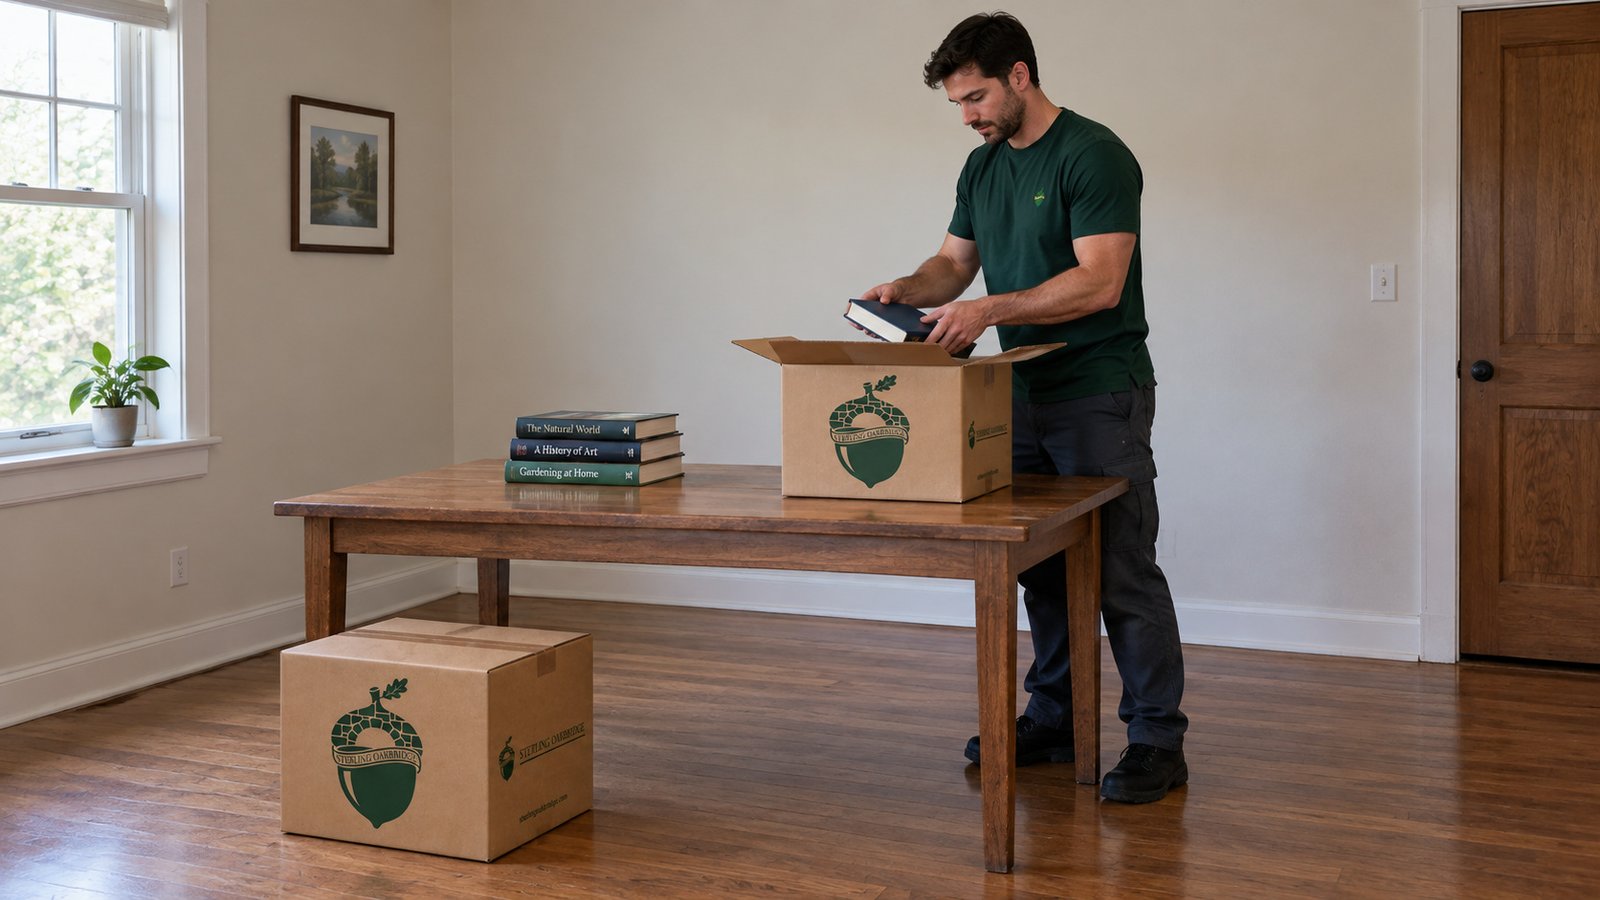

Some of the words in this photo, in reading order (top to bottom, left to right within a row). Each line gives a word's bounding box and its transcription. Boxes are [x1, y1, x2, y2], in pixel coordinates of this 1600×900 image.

[526, 424, 541, 433] The
[544, 424, 573, 434] Natural
[575, 424, 601, 434] World
[534, 446, 541, 454] A
[542, 445, 572, 457] History
[573, 445, 582, 455] of
[584, 447, 598, 456] Art
[519, 467, 562, 479] Gardening
[563, 469, 572, 477] at
[574, 468, 599, 478] Home
[336, 753, 372, 764] STERLING
